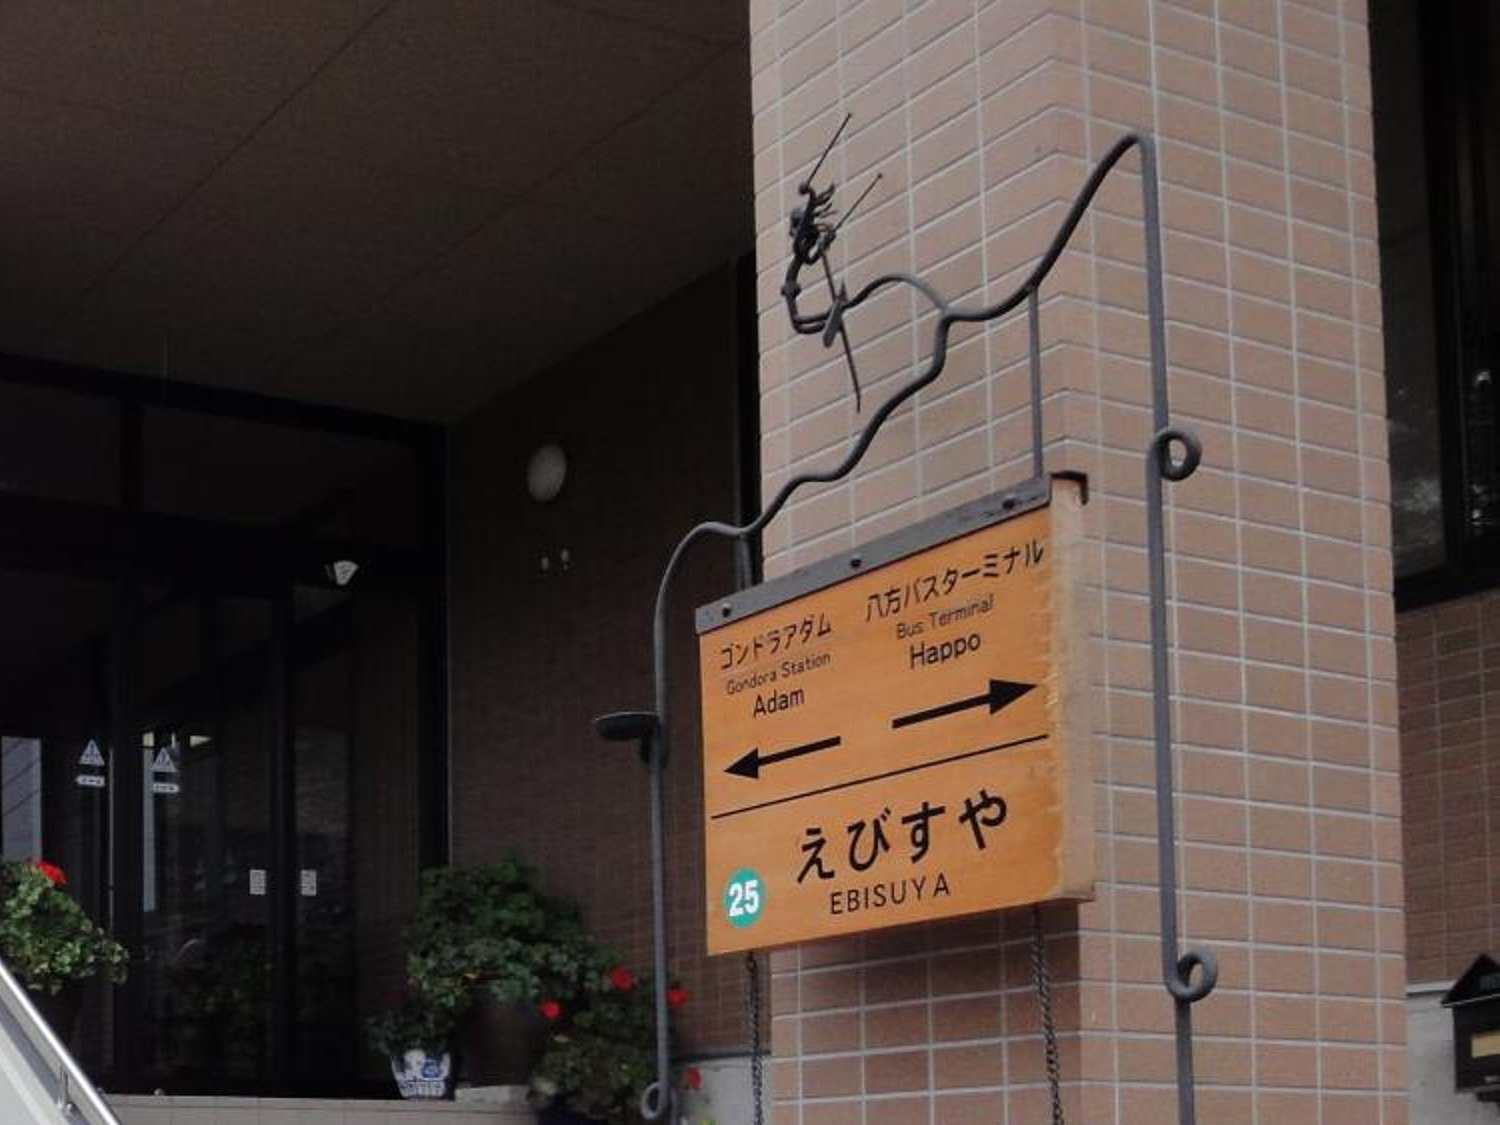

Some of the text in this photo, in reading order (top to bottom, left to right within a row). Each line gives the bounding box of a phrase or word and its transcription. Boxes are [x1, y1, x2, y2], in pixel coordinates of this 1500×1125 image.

[866, 539, 1045, 621] 八方バスターミナル
[896, 593, 995, 640] Bus Terminal
[721, 611, 832, 670] ゴンドラアダム
[909, 633, 981, 669] Happo
[726, 651, 831, 695] Gondora Station
[753, 688, 805, 719] Adam
[797, 789, 1007, 883] えびすや
[728, 880, 760, 918] 25
[831, 872, 950, 915] EBISUYA
